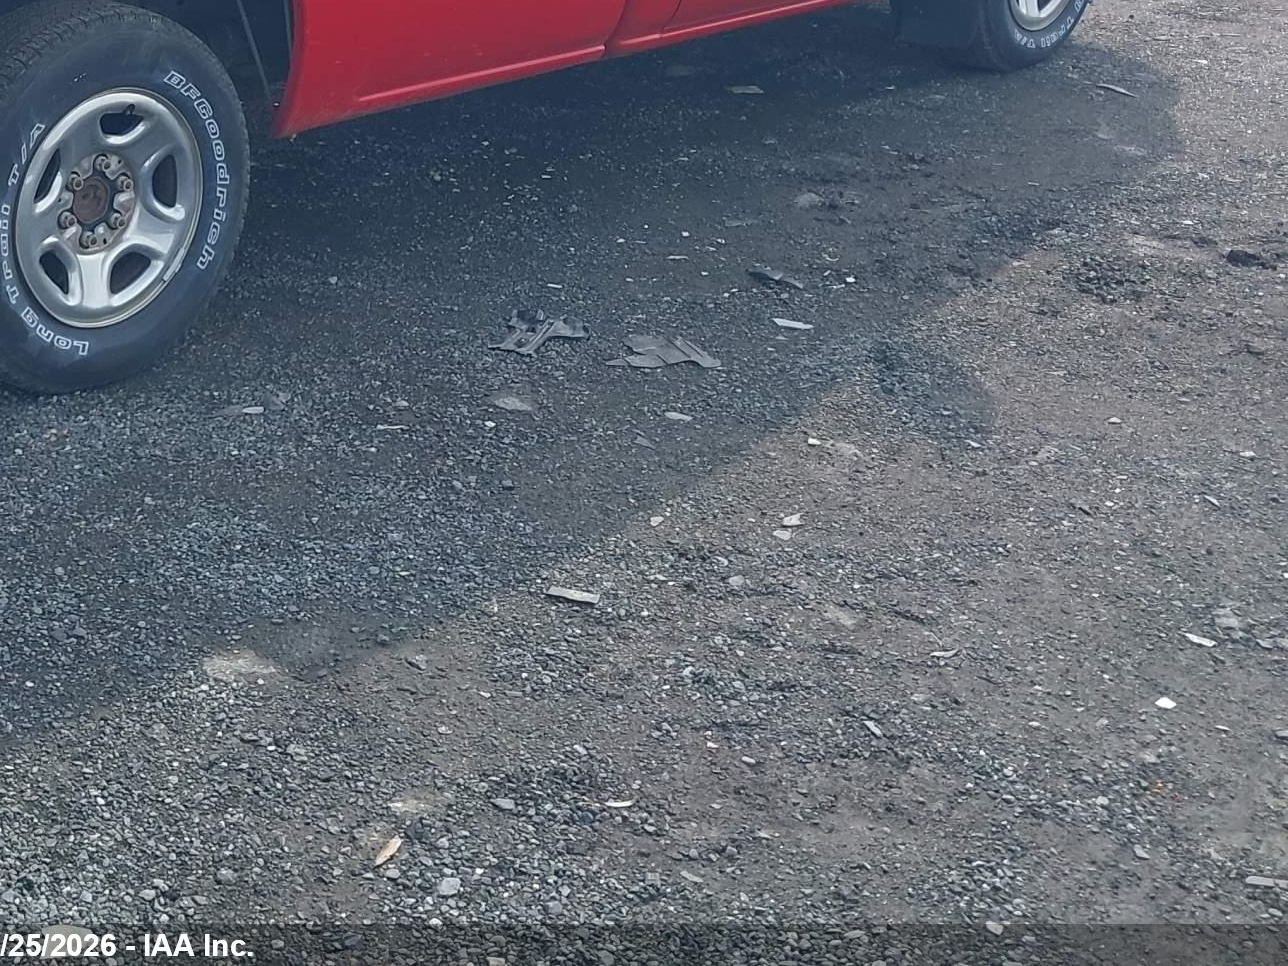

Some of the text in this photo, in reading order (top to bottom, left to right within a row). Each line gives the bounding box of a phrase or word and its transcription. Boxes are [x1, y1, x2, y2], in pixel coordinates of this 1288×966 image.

[8, 122, 46, 187] T/A
[163, 69, 229, 271] BFGoodrich
[21, 306, 89, 355] Long
